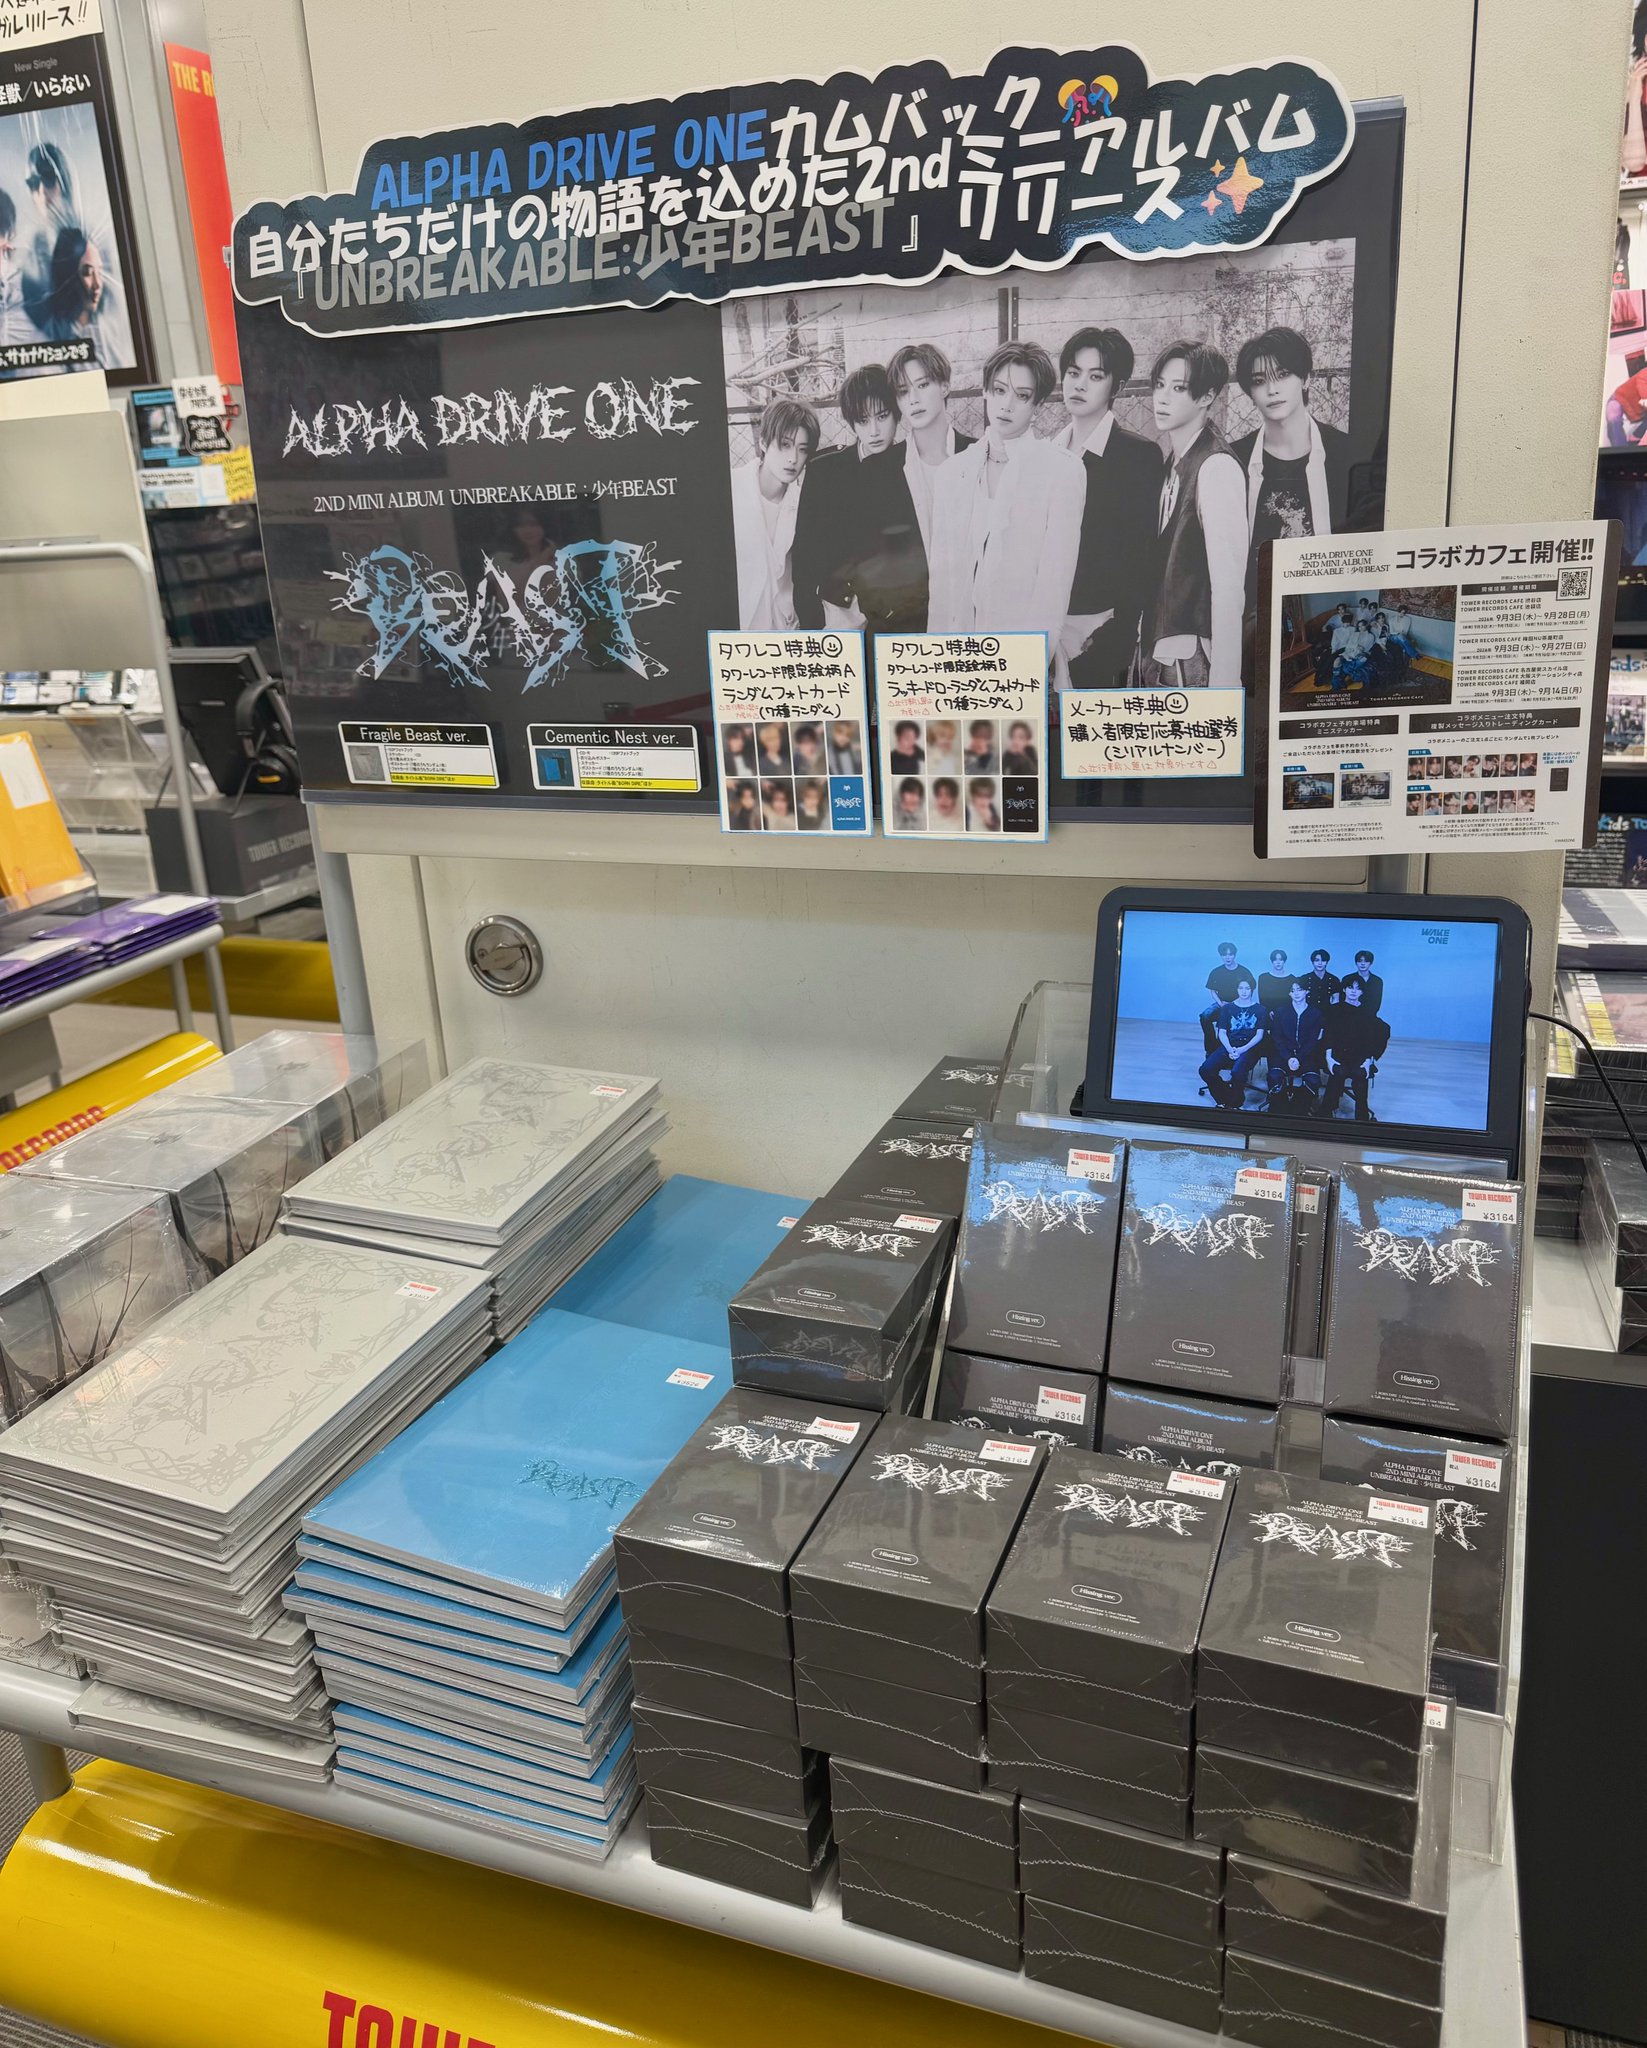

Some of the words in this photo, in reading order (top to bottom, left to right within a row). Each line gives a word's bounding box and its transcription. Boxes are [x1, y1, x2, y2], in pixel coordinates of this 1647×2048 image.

[14, 62, 32, 73] New
[33, 57, 58, 70] Single
[172, 60, 201, 94] THE
[371, 148, 512, 211] ALPHA
[528, 125, 656, 190] DRIVE
[282, 394, 429, 459] ALPHA
[430, 383, 577, 447] DRIVE
[584, 376, 702, 440] ONE
[314, 495, 346, 512] 2ND
[348, 493, 385, 510] MINI
[388, 489, 444, 508] ALBUM
[450, 483, 577, 506] UNBREAKABLE
[1298, 552, 1327, 561] ALPHA
[1328, 551, 1354, 559] DRIVE
[1356, 549, 1374, 557] ONE
[1396, 538, 1595, 569] コラボカフェ開催!!
[1302, 561, 1320, 569] 2ND
[1320, 559, 1340, 567] MINI
[1340, 557, 1372, 566] ALBUM
[1283, 567, 1344, 578] UNBREAKABLE
[719, 636, 823, 660] タワレコ特典
[892, 637, 982, 658] タワレコ特典
[1070, 694, 1166, 717] メーカー特典
[1457, 713, 1533, 722] コラボメニュー注文特典
[360, 727, 401, 743] Fragile
[405, 728, 443, 741] Beast
[446, 731, 470, 742] ver.
[1068, 715, 1238, 743] 購入者限定応募抽選券
[544, 729, 610, 744] Cementic
[615, 730, 648, 744] Nest
[652, 734, 679, 744] ver.
[1421, 928, 1450, 936] WAKE
[1428, 936, 1448, 944] ONE
[1084, 1170, 1110, 1180] ¥3164
[1254, 1189, 1282, 1199] ¥3164
[1483, 1212, 1514, 1222] ¥3164
[1400, 1374, 1422, 1384] Hissing
[1044, 1389, 1059, 1400] TOWER
[1060, 1393, 1081, 1404] RECORDS
[1055, 1410, 1082, 1422] ¥3164
[1383, 1461, 1406, 1470] ALPHA
[1406, 1465, 1427, 1473] DRIVE
[1452, 1454, 1471, 1465] TOWER
[1471, 1458, 1496, 1469] RECORDS
[1370, 1472, 1419, 1485] UNBREAKABLE
[1400, 1470, 1416, 1478] MINI
[1416, 1473, 1440, 1482] ALBUM
[1465, 1476, 1497, 1489] ¥3164
[1391, 1515, 1425, 1526] ¥3164
